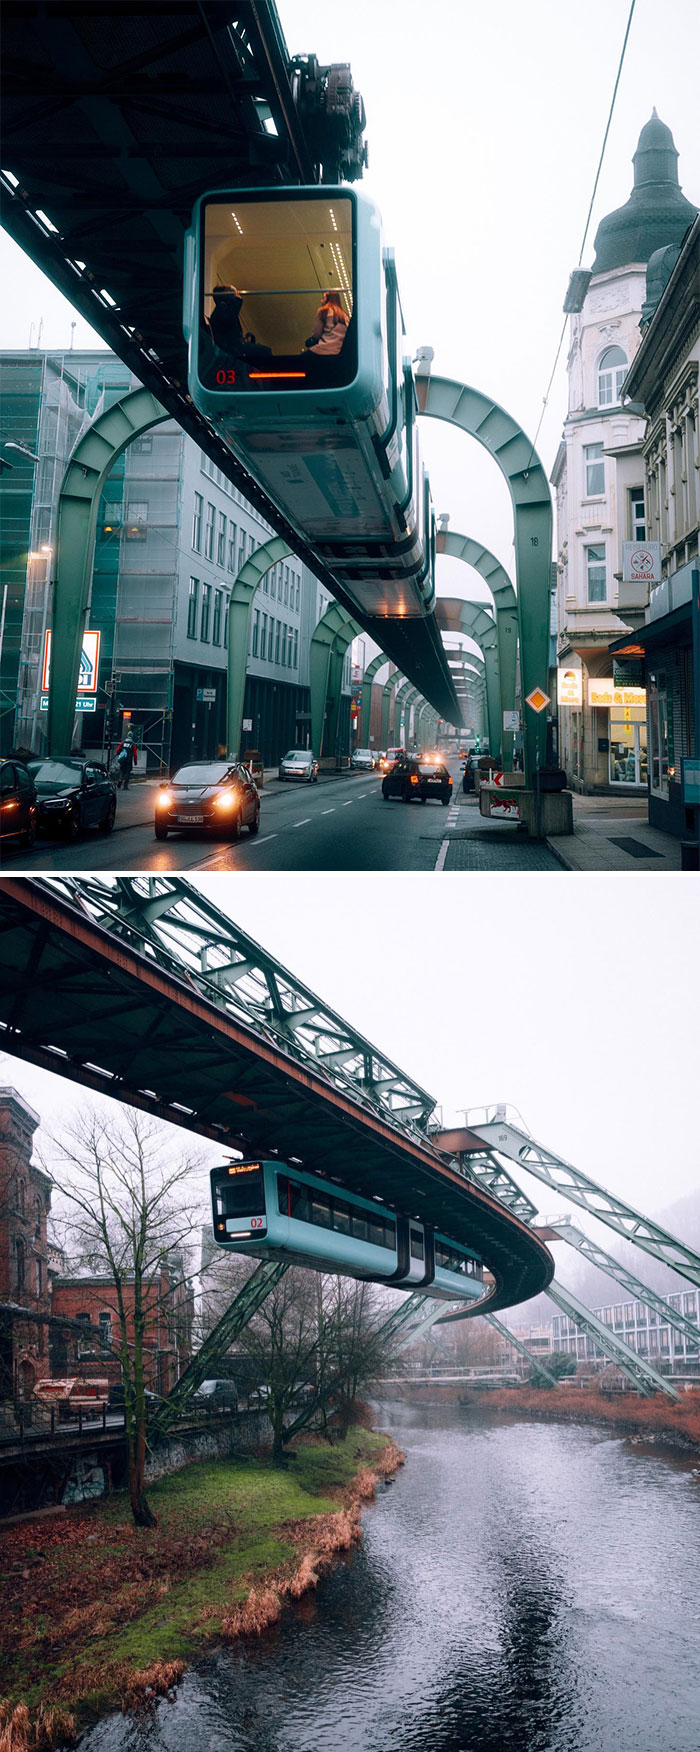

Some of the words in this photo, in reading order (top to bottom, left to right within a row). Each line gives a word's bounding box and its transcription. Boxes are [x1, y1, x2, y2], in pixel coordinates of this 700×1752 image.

[216, 369, 236, 385] 03
[530, 536, 539, 547] 18
[631, 572, 655, 580] SAHARA
[613, 691, 623, 704] &
[498, 1134, 508, 1142] 169
[250, 1217, 263, 1229] 02
